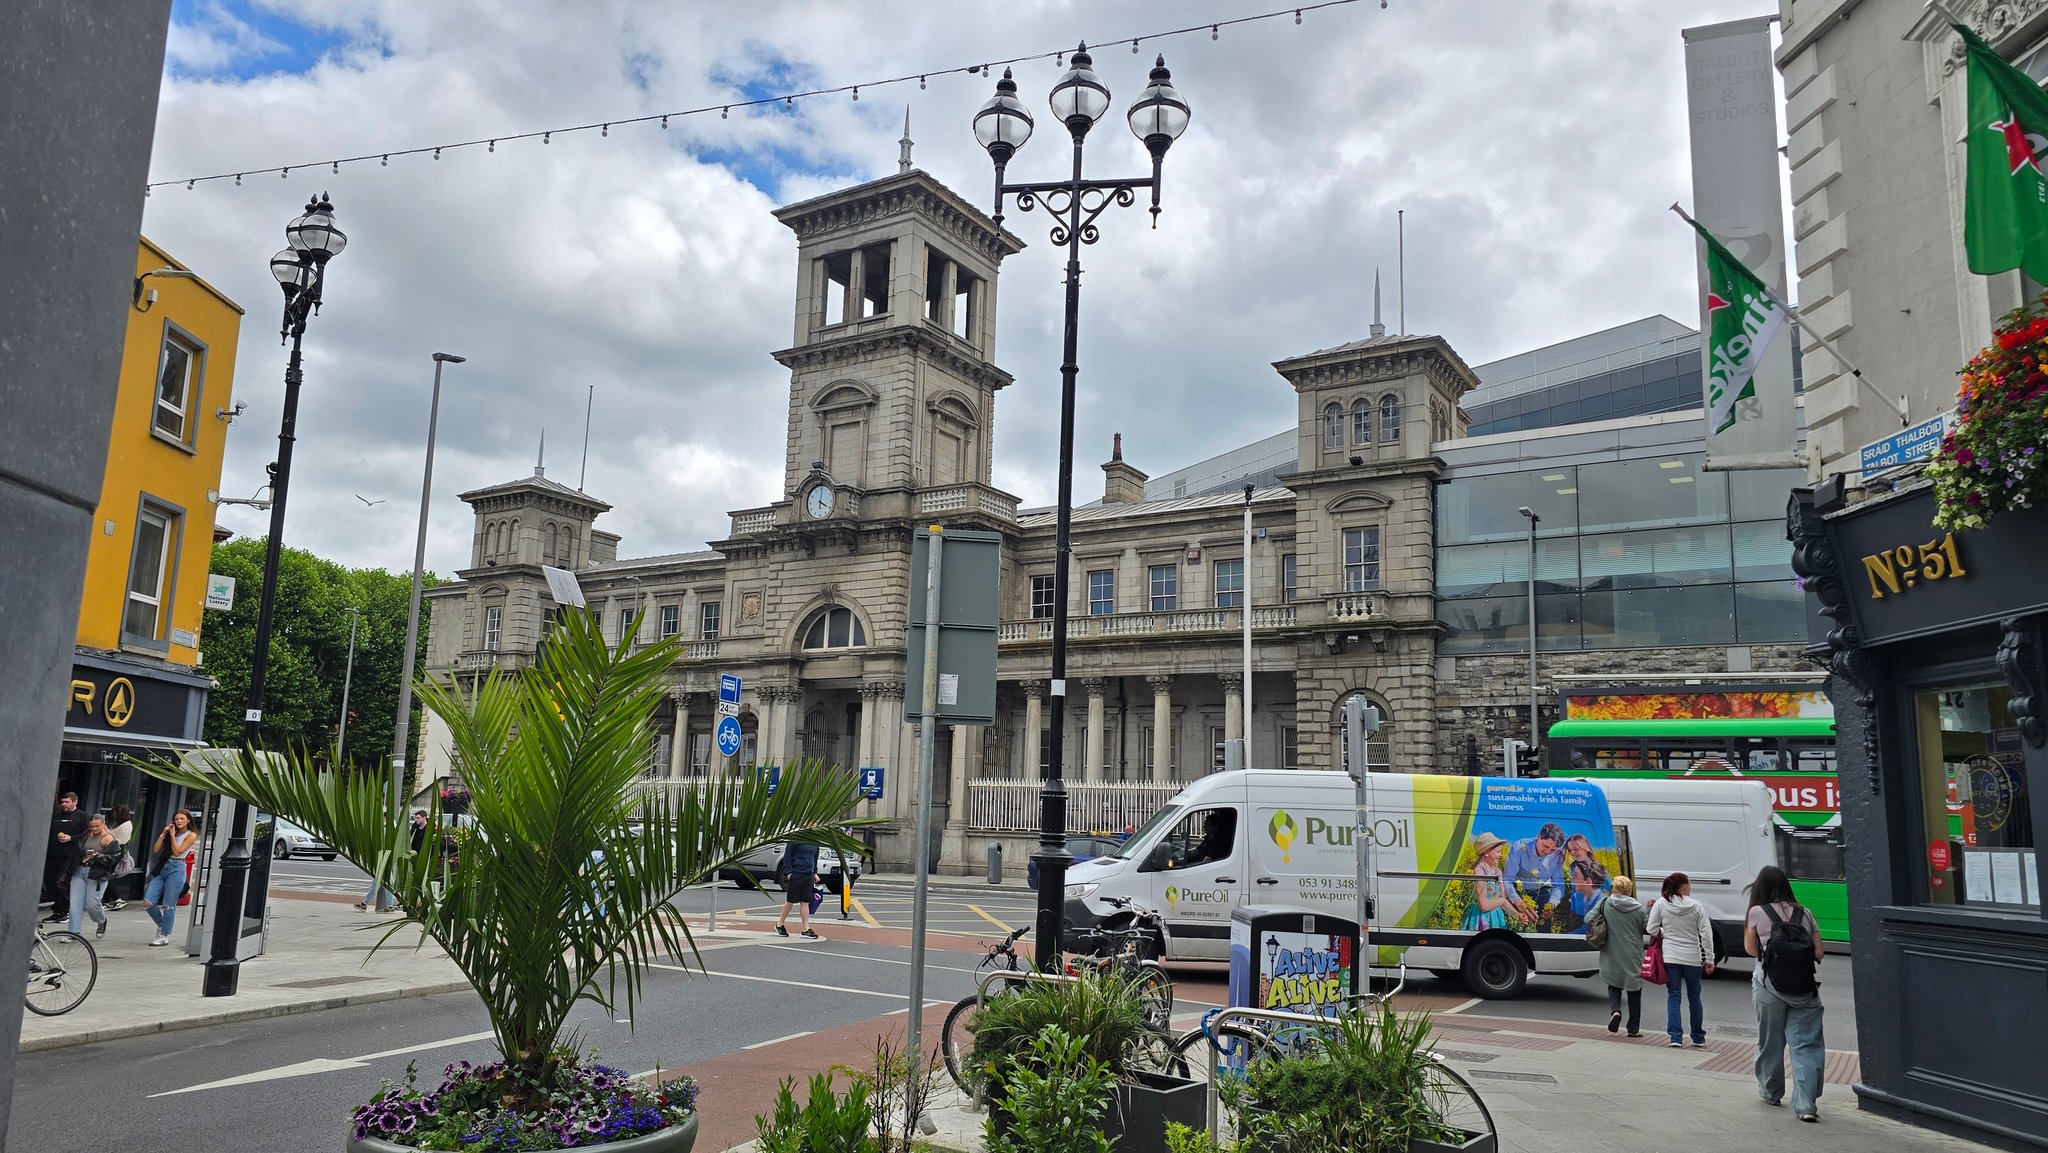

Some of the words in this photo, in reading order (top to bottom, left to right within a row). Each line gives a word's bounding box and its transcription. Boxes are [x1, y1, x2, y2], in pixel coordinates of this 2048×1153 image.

[1694, 102, 1769, 125] STUDIOS
[1863, 442, 1890, 461] SRÁID
[1895, 421, 1942, 448] THALBÓID
[1865, 453, 1899, 473] TALBOT
[720, 703, 729, 713] 24
[1486, 784, 1524, 793] pureoil.ie
[1527, 786, 1554, 794] award
[1487, 794, 1537, 803] sustainable,
[1539, 795, 1558, 803] Irish
[1561, 796, 1586, 806] family
[1488, 802, 1524, 811] business
[1299, 878, 1317, 888] 053
[1321, 878, 1332, 888] 91
[1181, 888, 1229, 903] PureOil
